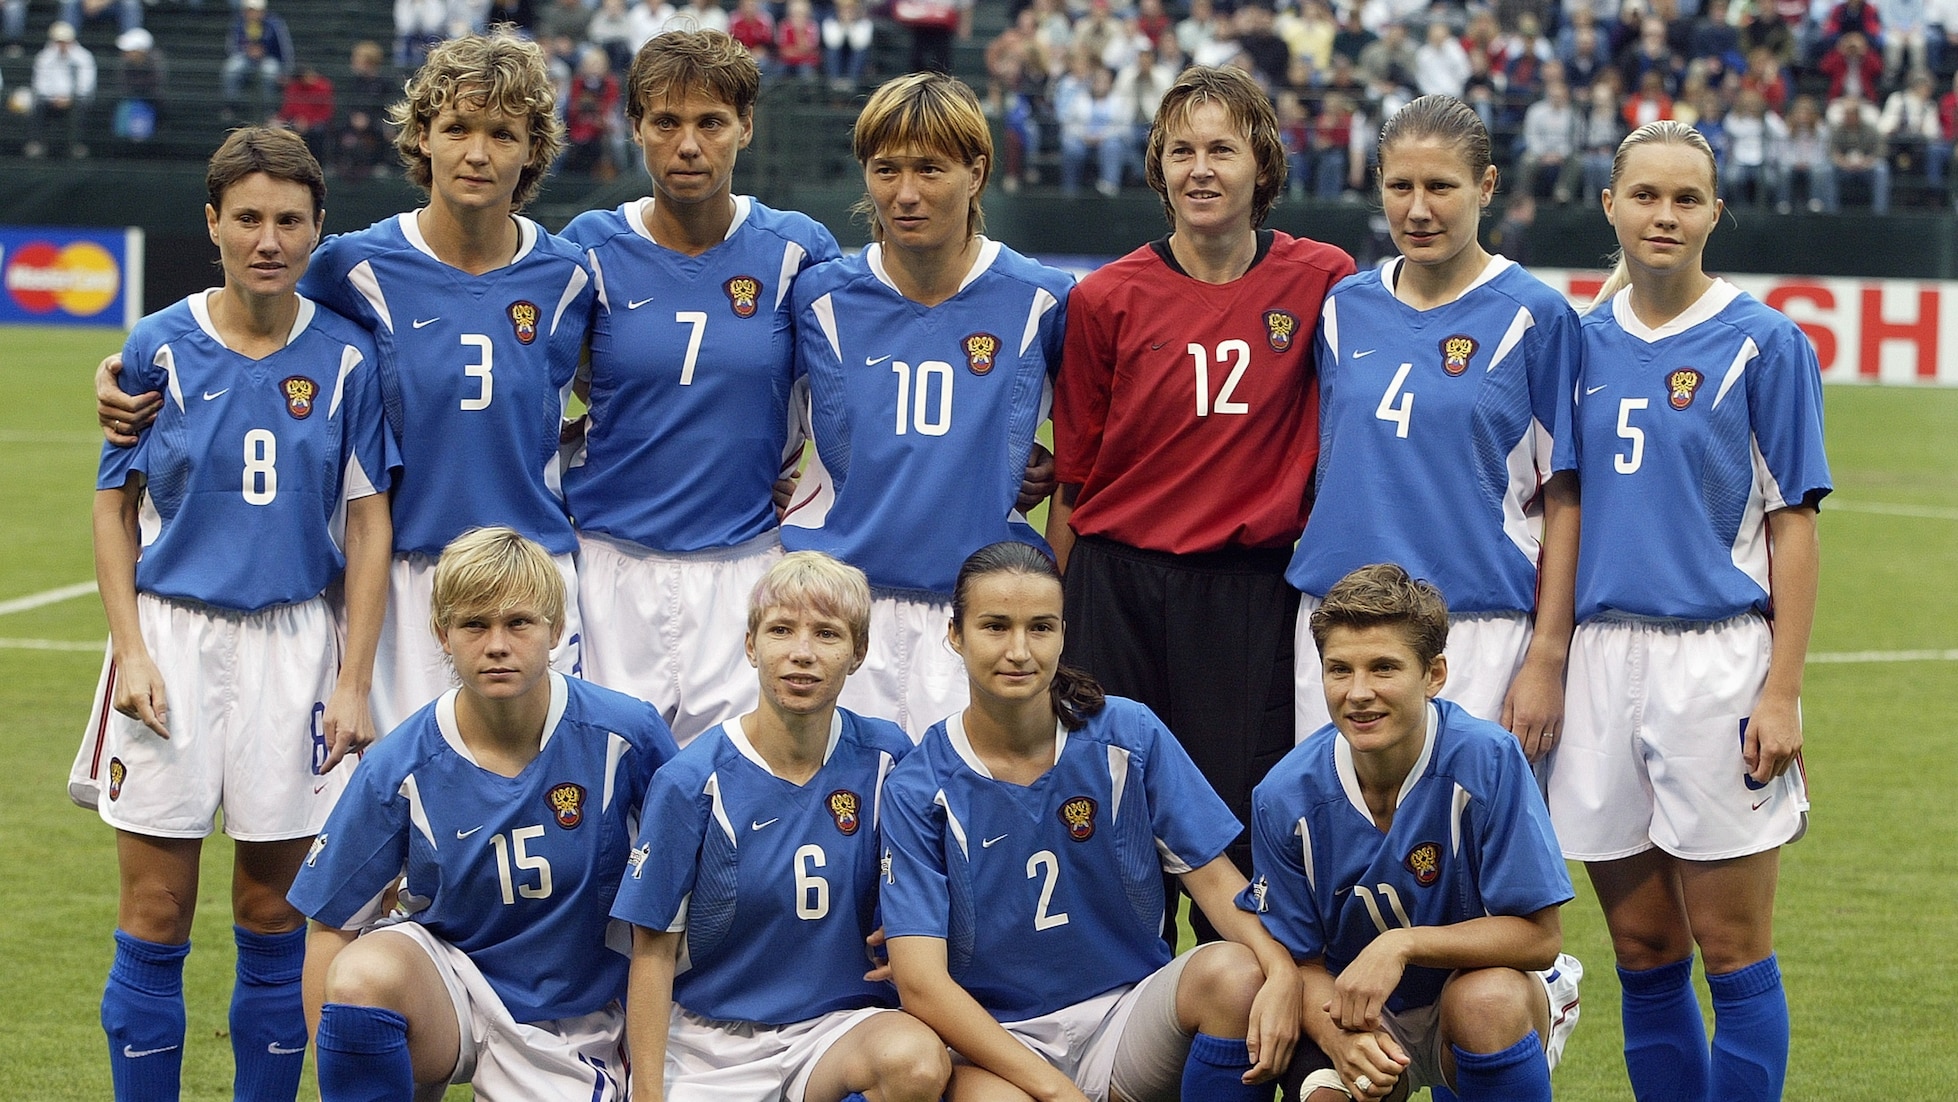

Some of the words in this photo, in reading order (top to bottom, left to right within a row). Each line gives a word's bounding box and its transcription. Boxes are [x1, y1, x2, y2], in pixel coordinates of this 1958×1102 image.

[461, 334, 492, 411] 3
[676, 312, 707, 385] 7
[1188, 340, 1250, 416] 12
[893, 361, 953, 436] 10
[1376, 364, 1414, 439] 4
[1615, 398, 1648, 475] 5
[243, 429, 276, 505] 8
[490, 825, 552, 904] 15
[794, 844, 828, 920] 6
[1027, 850, 1069, 931] 2
[1354, 883, 1412, 933] 11
